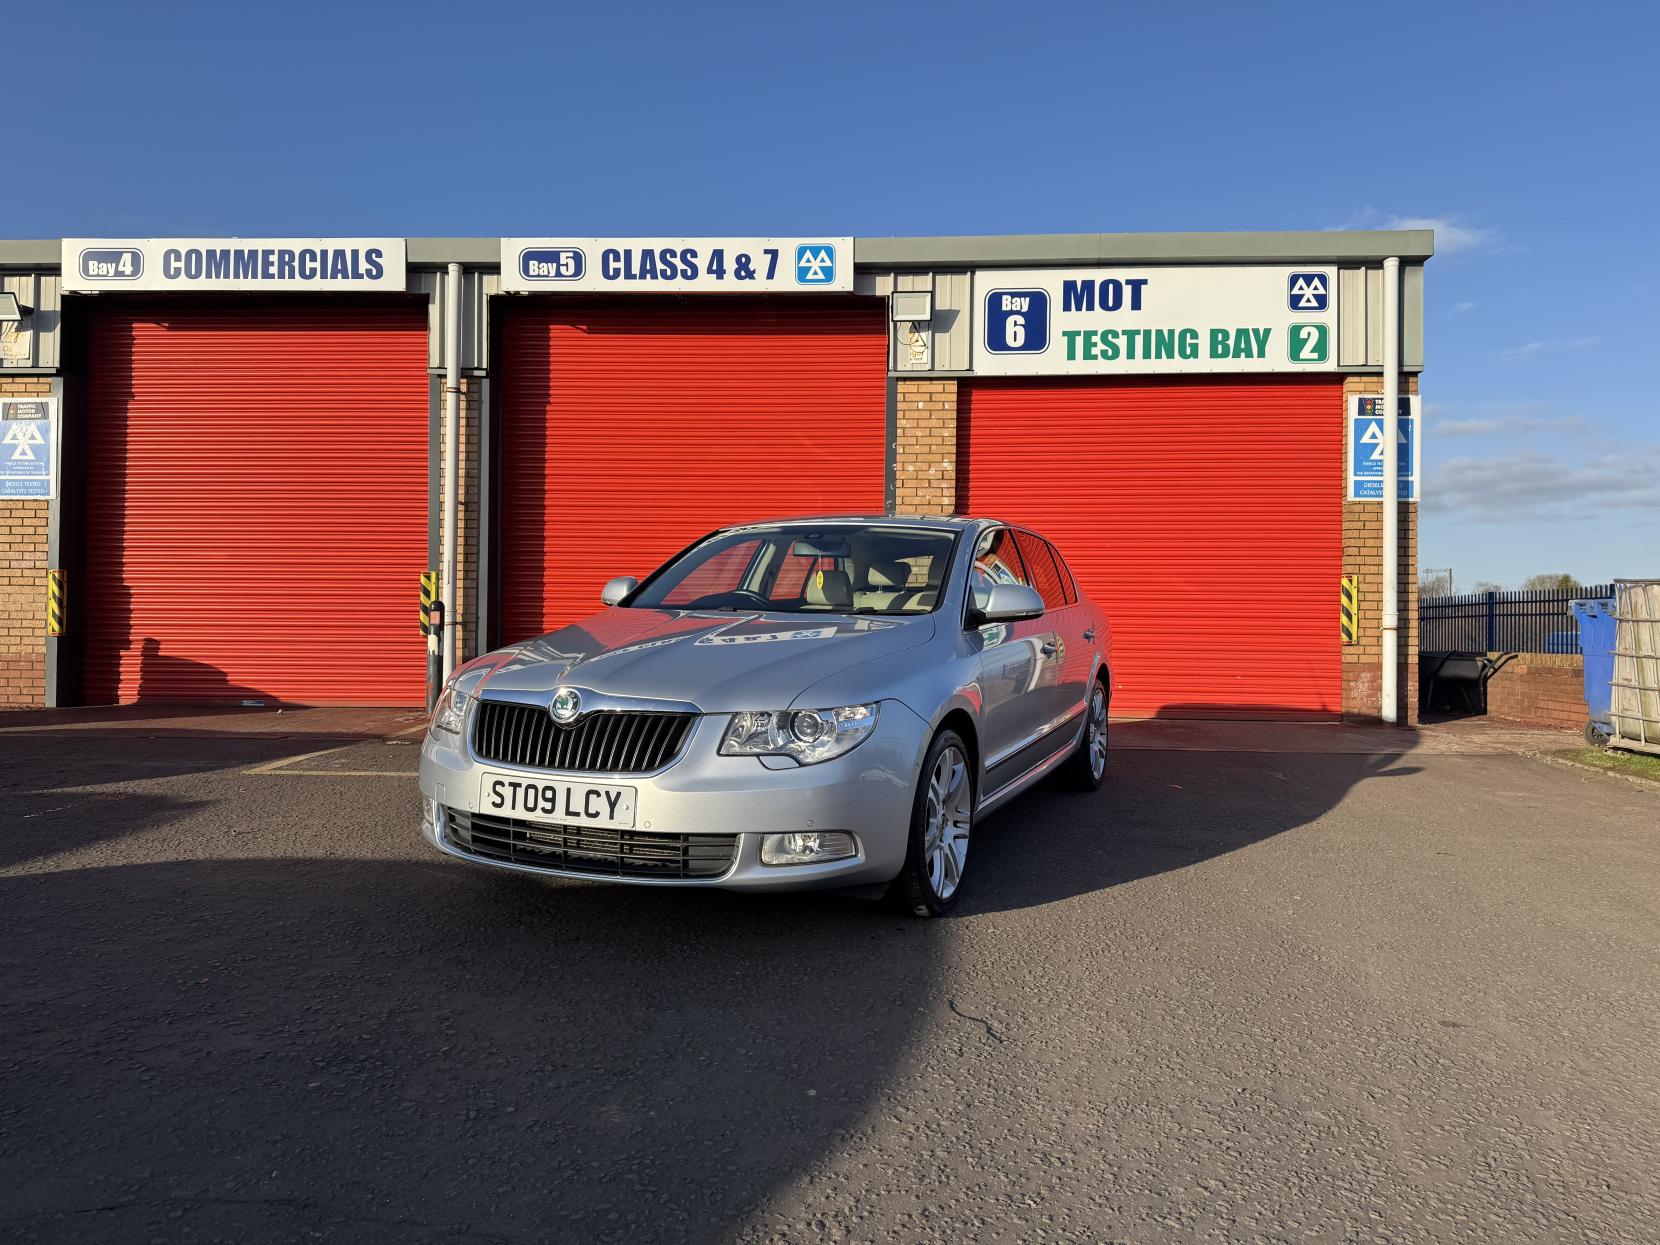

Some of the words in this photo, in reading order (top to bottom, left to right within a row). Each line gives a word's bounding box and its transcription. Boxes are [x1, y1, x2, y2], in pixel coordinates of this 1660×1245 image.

[88, 260, 116, 277] Bay
[117, 252, 133, 275] 4
[163, 248, 384, 280] COMMERCIALS
[528, 260, 556, 278] Bay
[558, 251, 575, 276] 5
[601, 248, 699, 281] CLASS
[706, 248, 727, 280] 4
[734, 252, 757, 281] &
[763, 248, 780, 280] 7
[1001, 294, 1029, 312] Bay
[1062, 278, 1148, 312] MOT
[1005, 314, 1026, 348] 6
[1062, 327, 1199, 361] TESTING
[1209, 327, 1272, 359] BAY
[1298, 325, 1320, 360] 2
[491, 780, 557, 815] ST09
[565, 787, 622, 821] LCY
